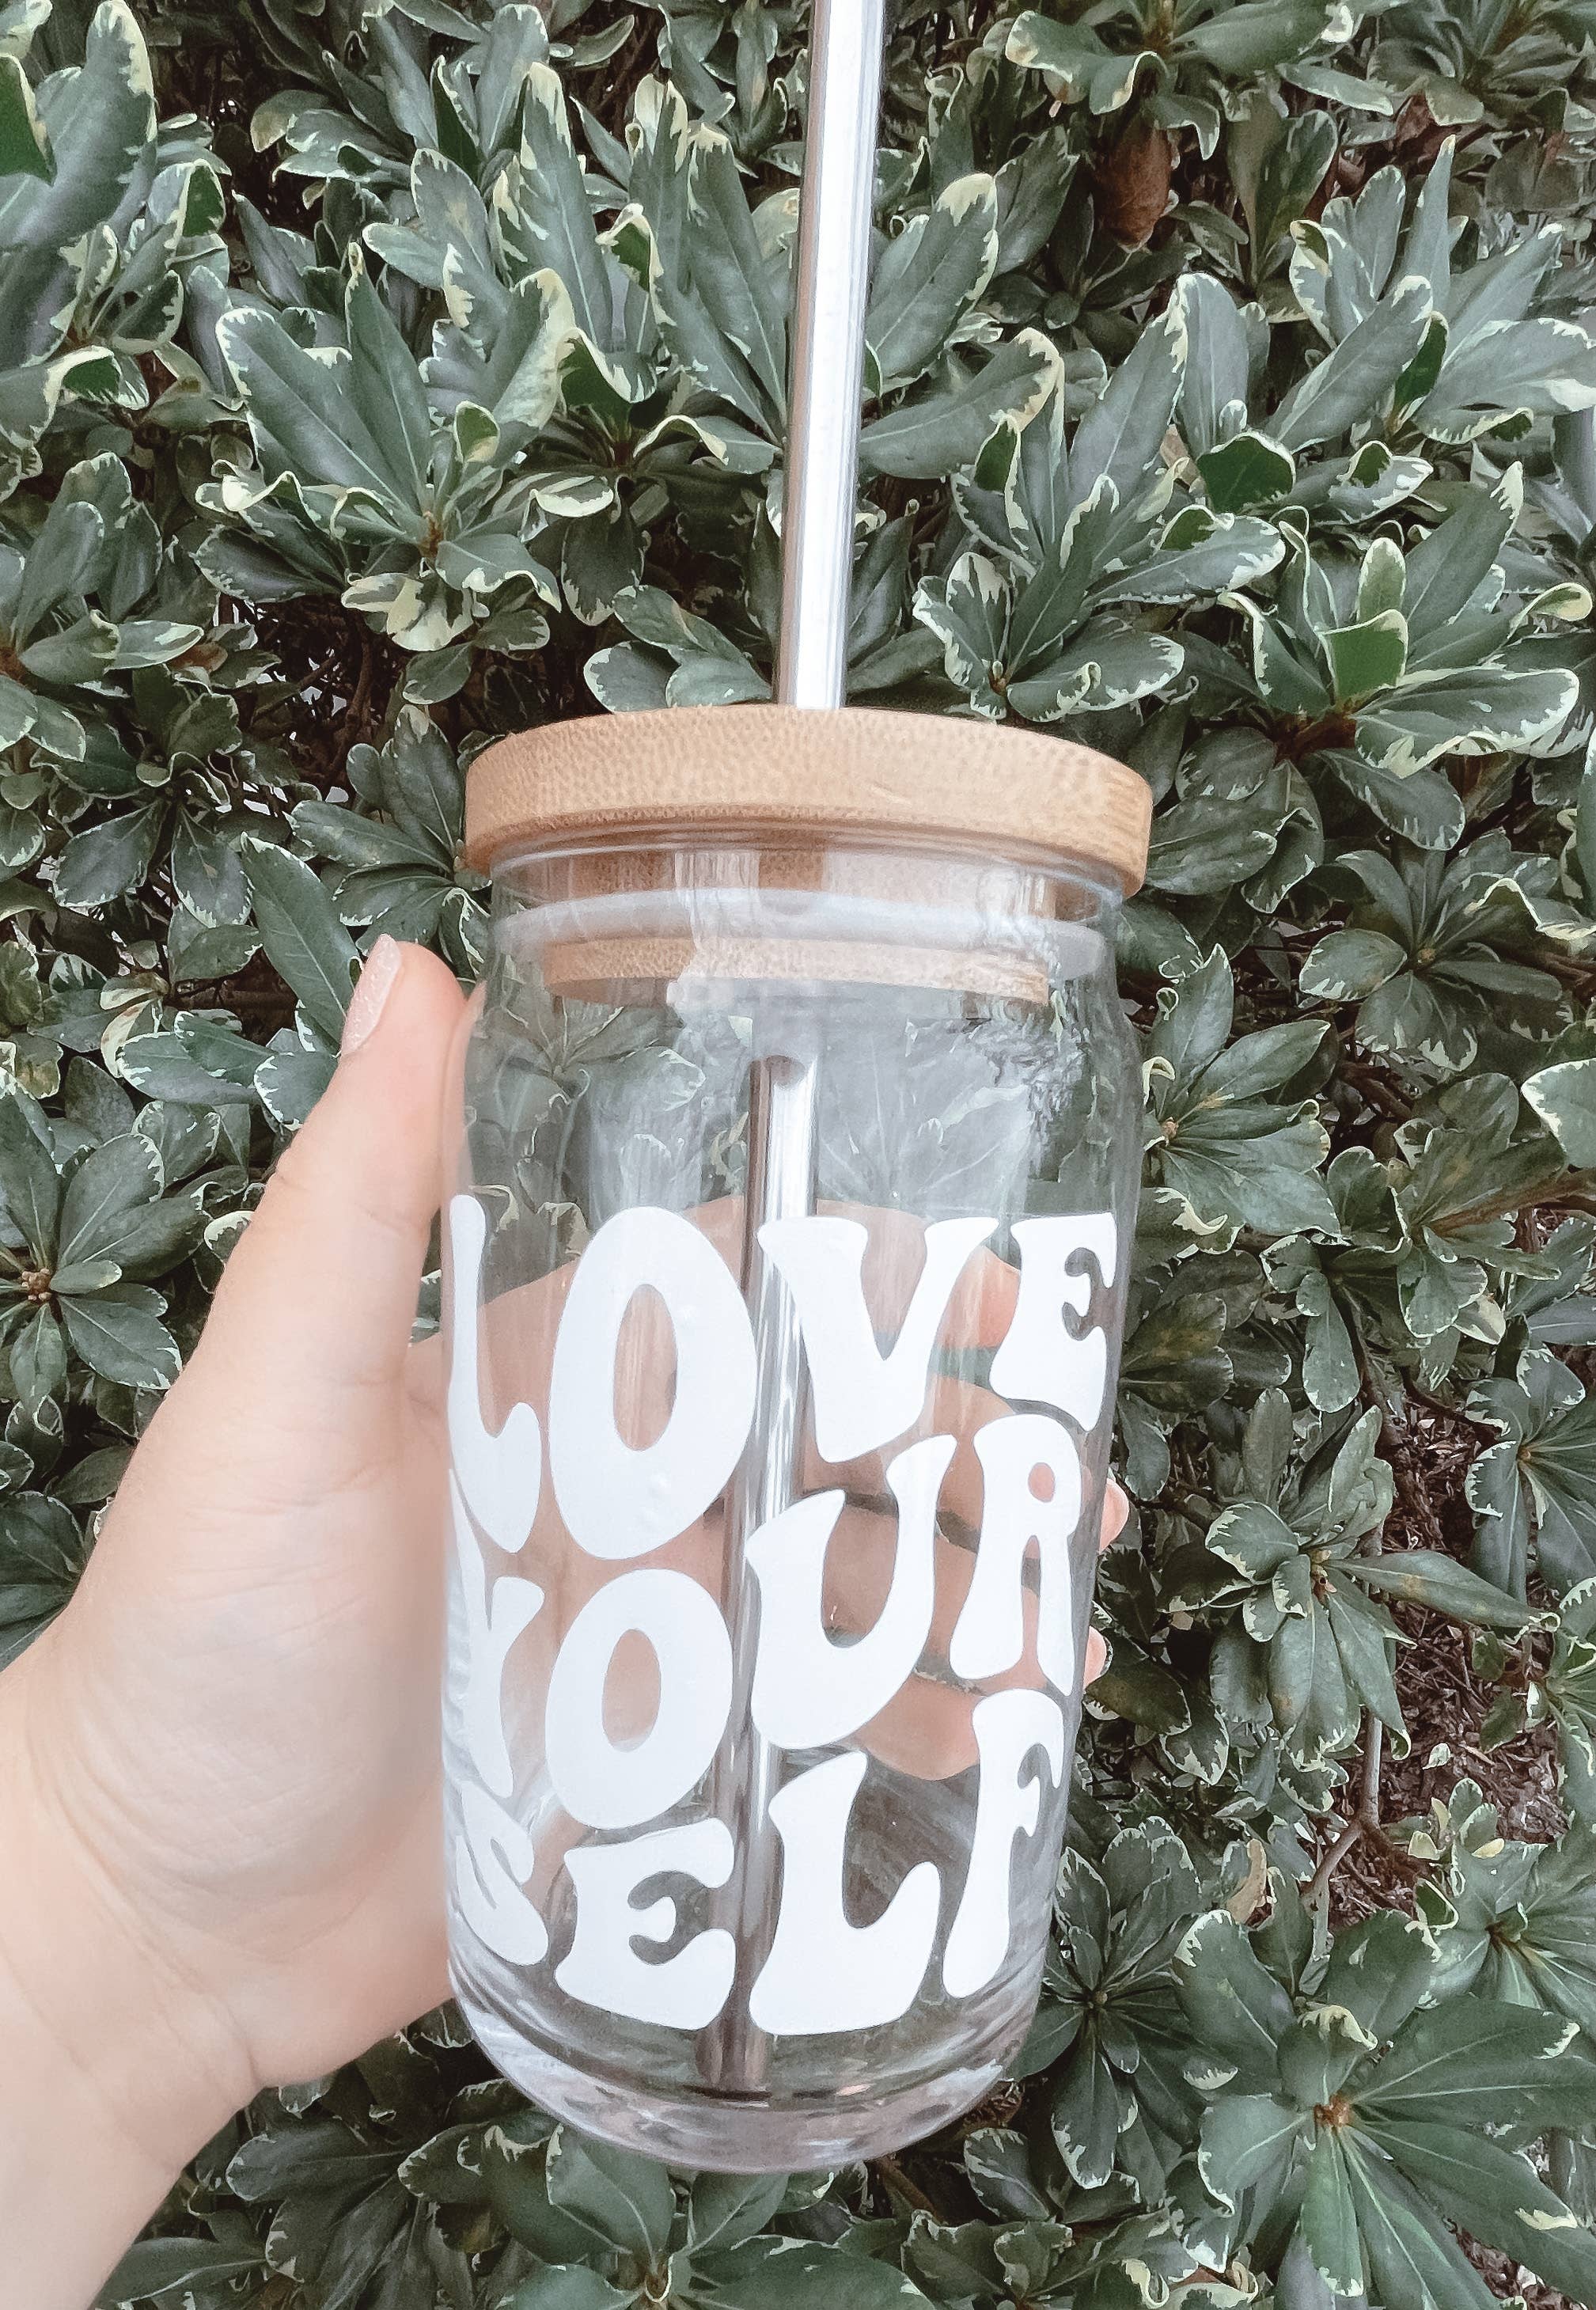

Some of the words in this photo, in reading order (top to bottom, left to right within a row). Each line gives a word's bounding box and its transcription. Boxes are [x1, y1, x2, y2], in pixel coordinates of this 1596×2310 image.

[448, 1195, 1117, 1559] LOVE
[447, 1414, 1081, 1830] YOUR
[455, 1688, 1063, 2035] SELF
